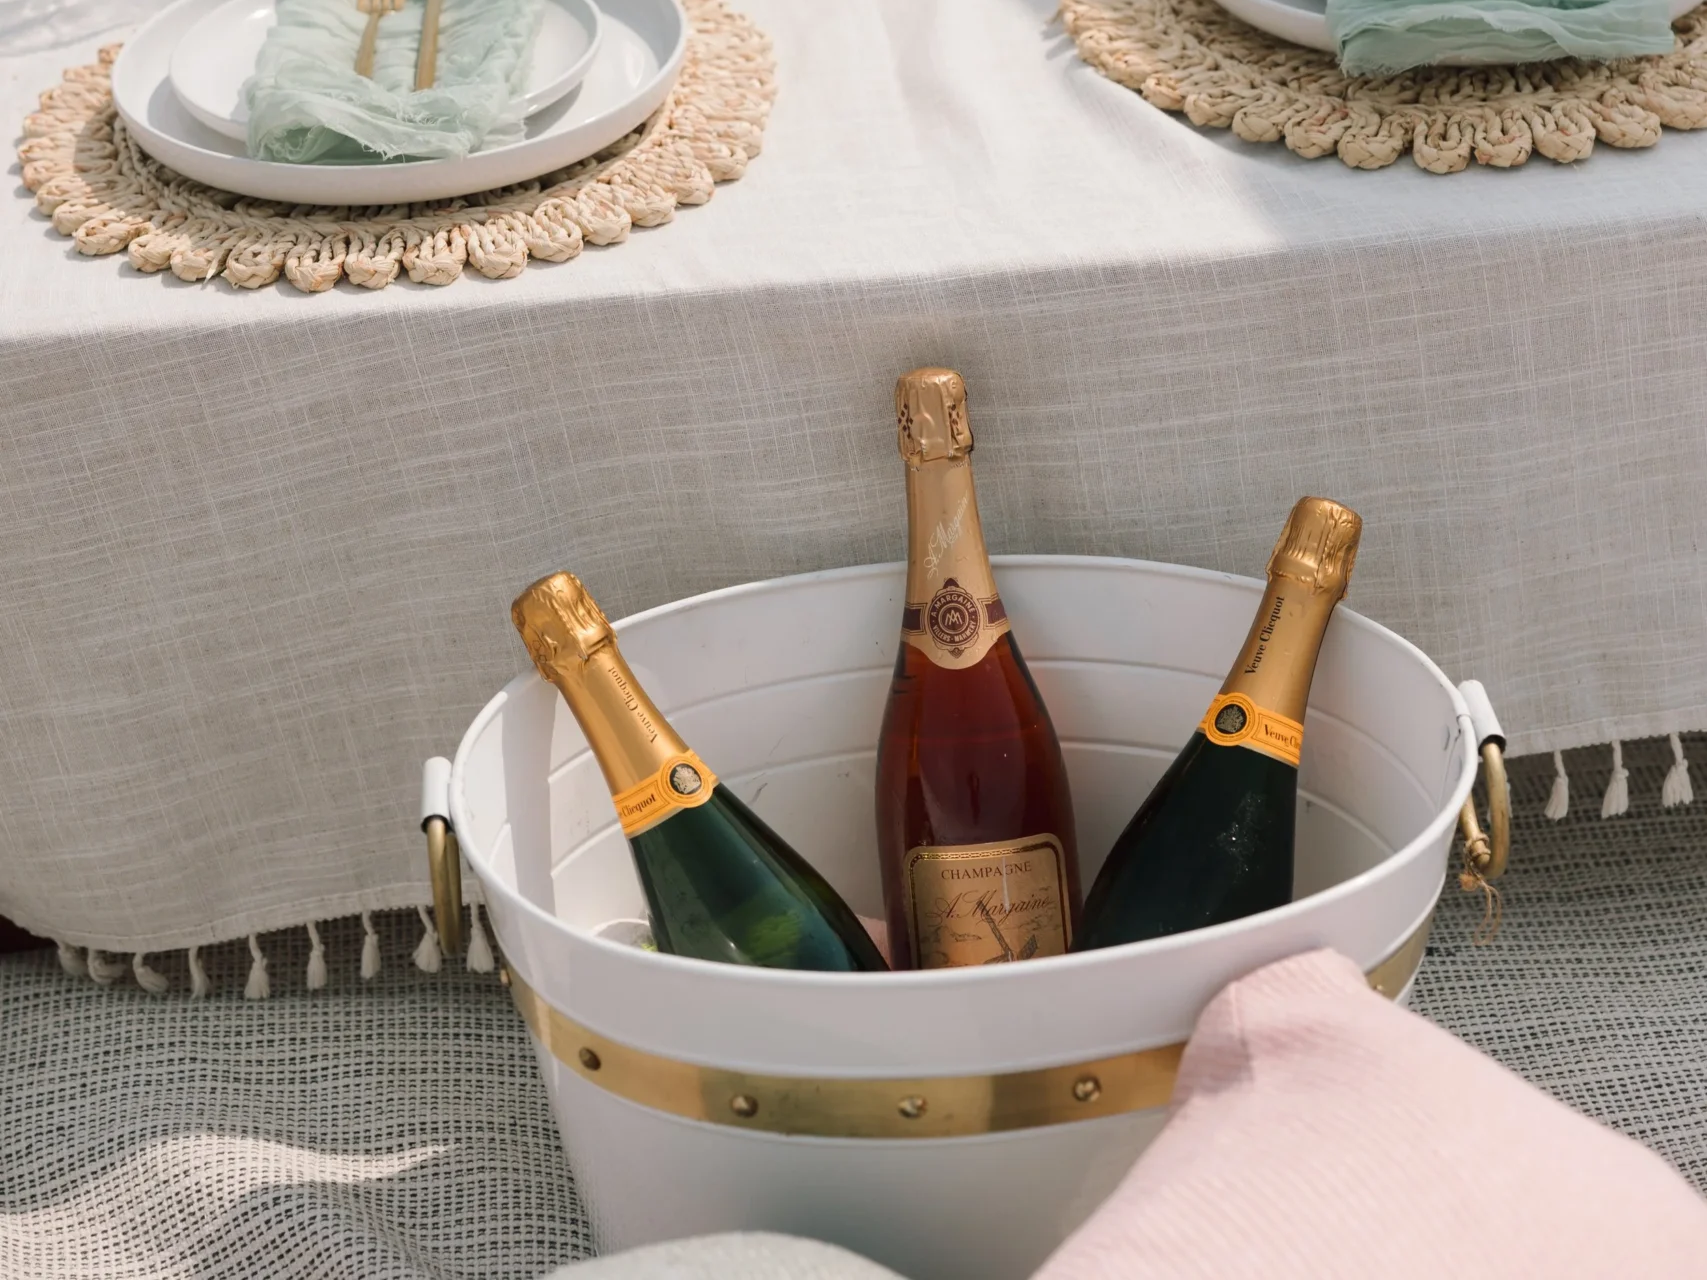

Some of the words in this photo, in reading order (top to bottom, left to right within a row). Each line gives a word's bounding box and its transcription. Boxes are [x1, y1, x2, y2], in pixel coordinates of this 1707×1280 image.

[930, 489, 968, 558] Margain
[934, 594, 975, 613] MARGAINE
[1244, 644, 1267, 675] Veuve
[1259, 596, 1285, 642] Clicquot
[608, 665, 639, 712] Clicquot
[636, 710, 659, 744] Veuve
[1264, 723, 1289, 747] Veuve
[621, 793, 656, 817] Clicquot
[941, 861, 1032, 880] CHAMPAGNE
[961, 889, 1050, 928] Margaine
